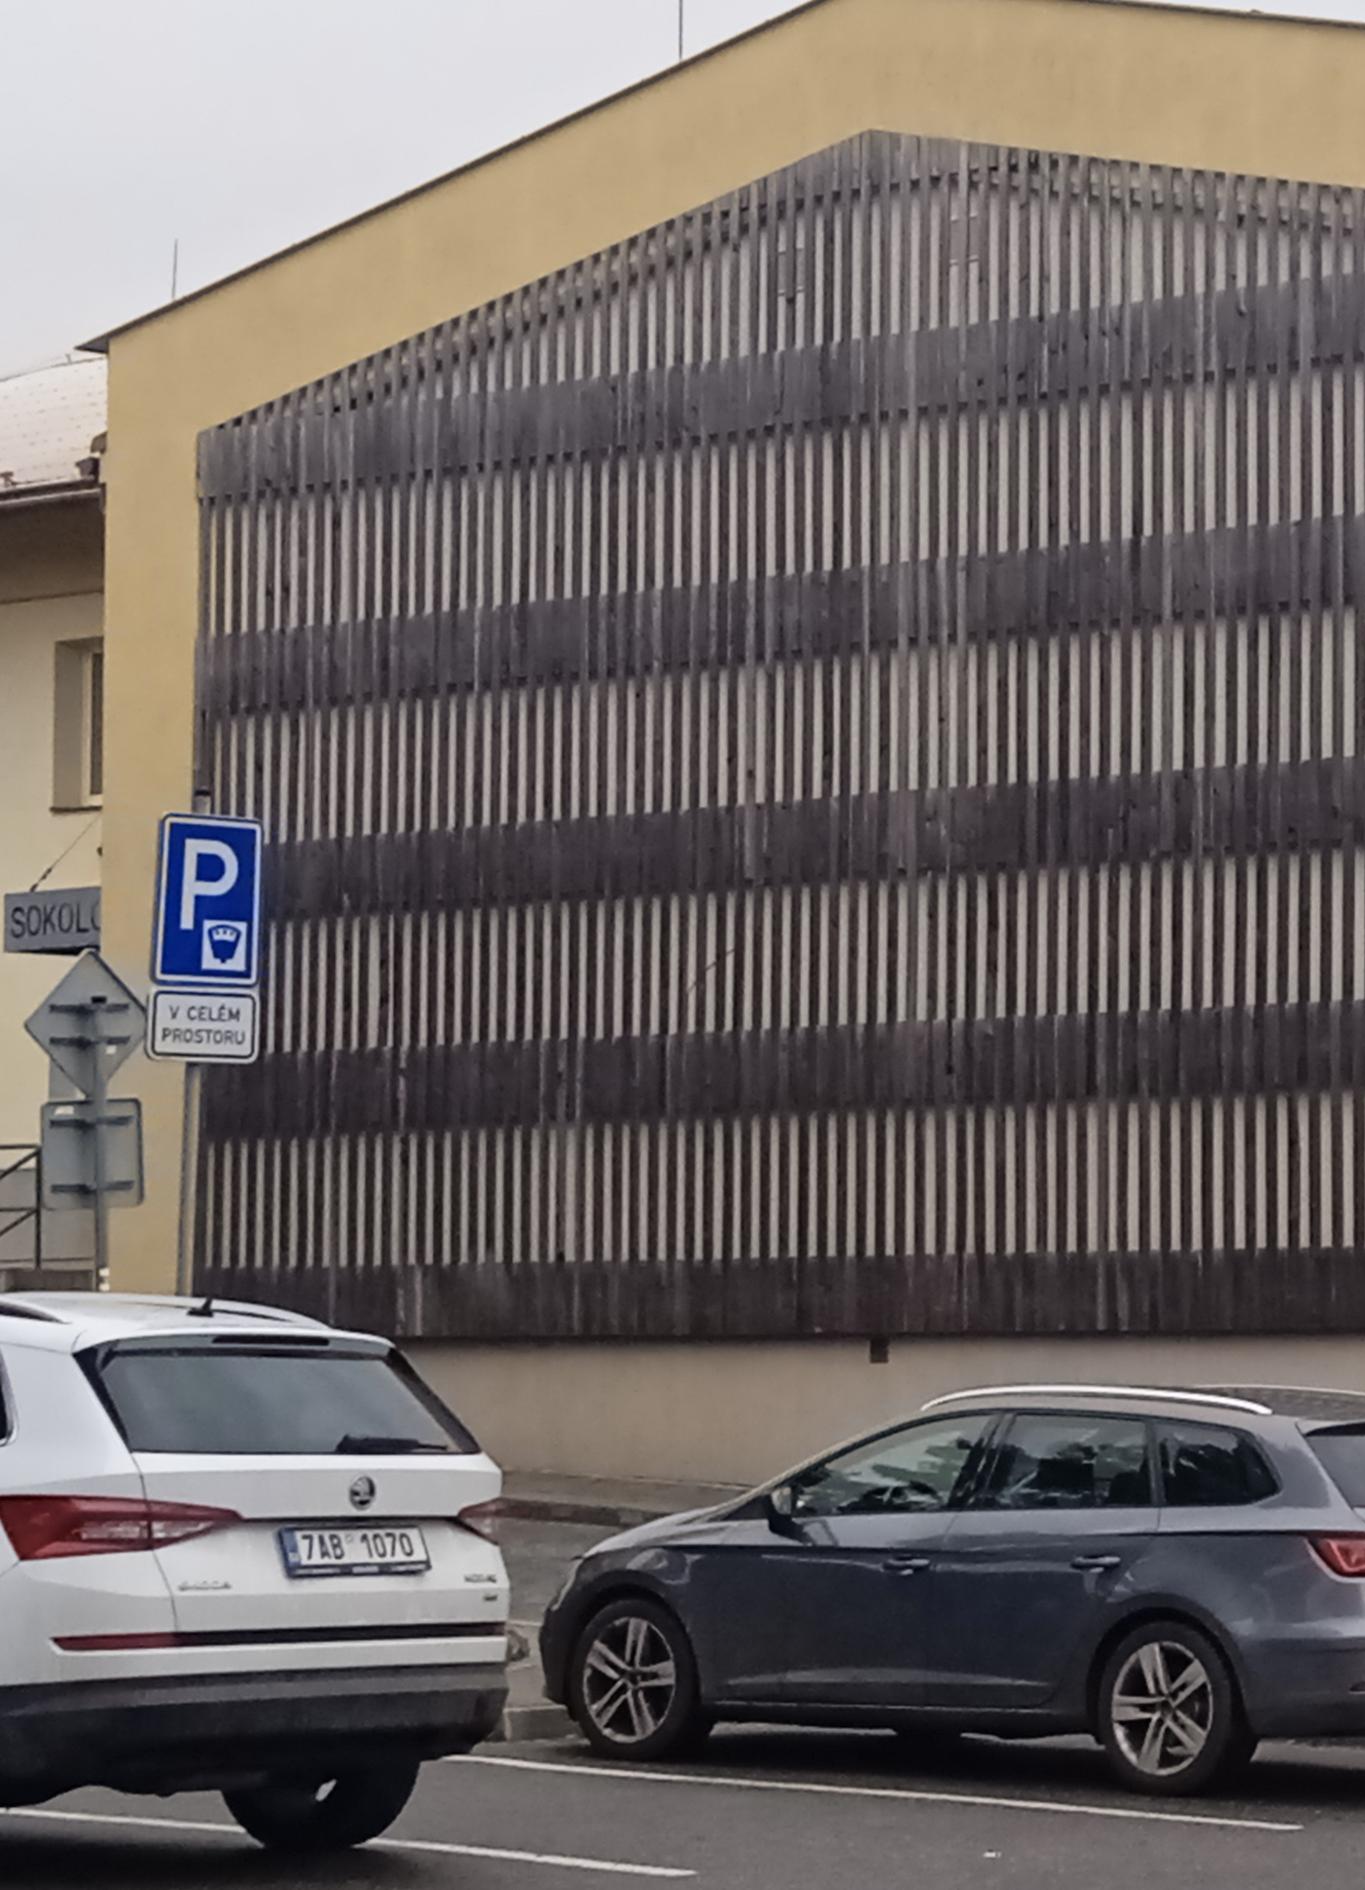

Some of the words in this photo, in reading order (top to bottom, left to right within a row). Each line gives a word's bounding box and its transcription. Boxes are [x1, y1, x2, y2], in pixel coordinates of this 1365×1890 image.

[180, 837, 239, 930] P
[168, 1004, 179, 1020] V
[187, 1003, 241, 1022] CELÉM
[162, 1027, 246, 1045] PROSTORU
[302, 1533, 345, 1560] 7AB
[360, 1532, 414, 1558] 1070
